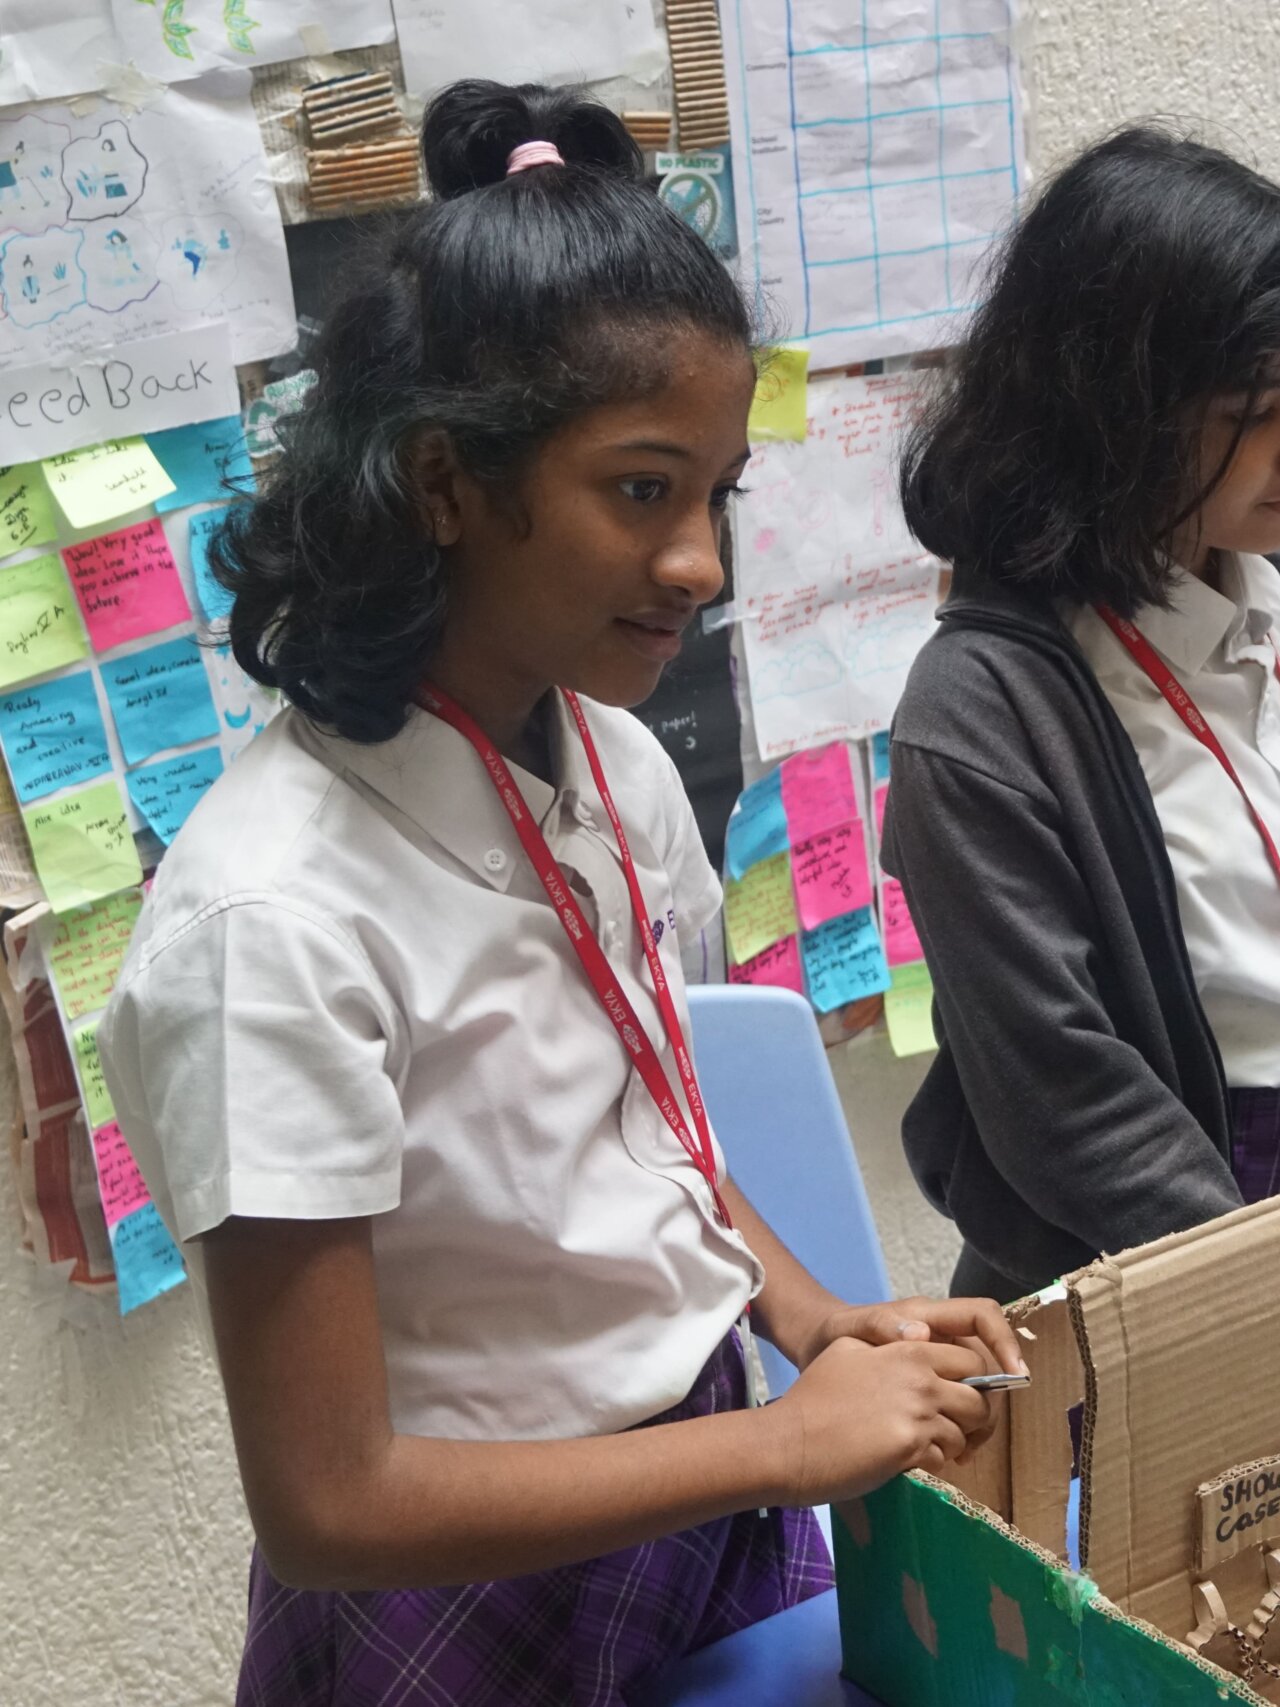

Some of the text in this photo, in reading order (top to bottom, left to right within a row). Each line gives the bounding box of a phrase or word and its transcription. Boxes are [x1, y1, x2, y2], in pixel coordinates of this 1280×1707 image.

[675, 156, 720, 170] PLASTIC
[0, 359, 213, 428] eed Back
[1166, 678, 1188, 707] EKYA
[571, 699, 589, 735] EKYA
[486, 749, 506, 786] EKYA
[615, 827, 631, 864] EKYA
[545, 871, 569, 907] EKYA
[650, 955, 666, 993] EKYA
[602, 987, 627, 1026] EKYA
[661, 1094, 681, 1130] EKYA
[687, 1081, 704, 1119] EKYA
